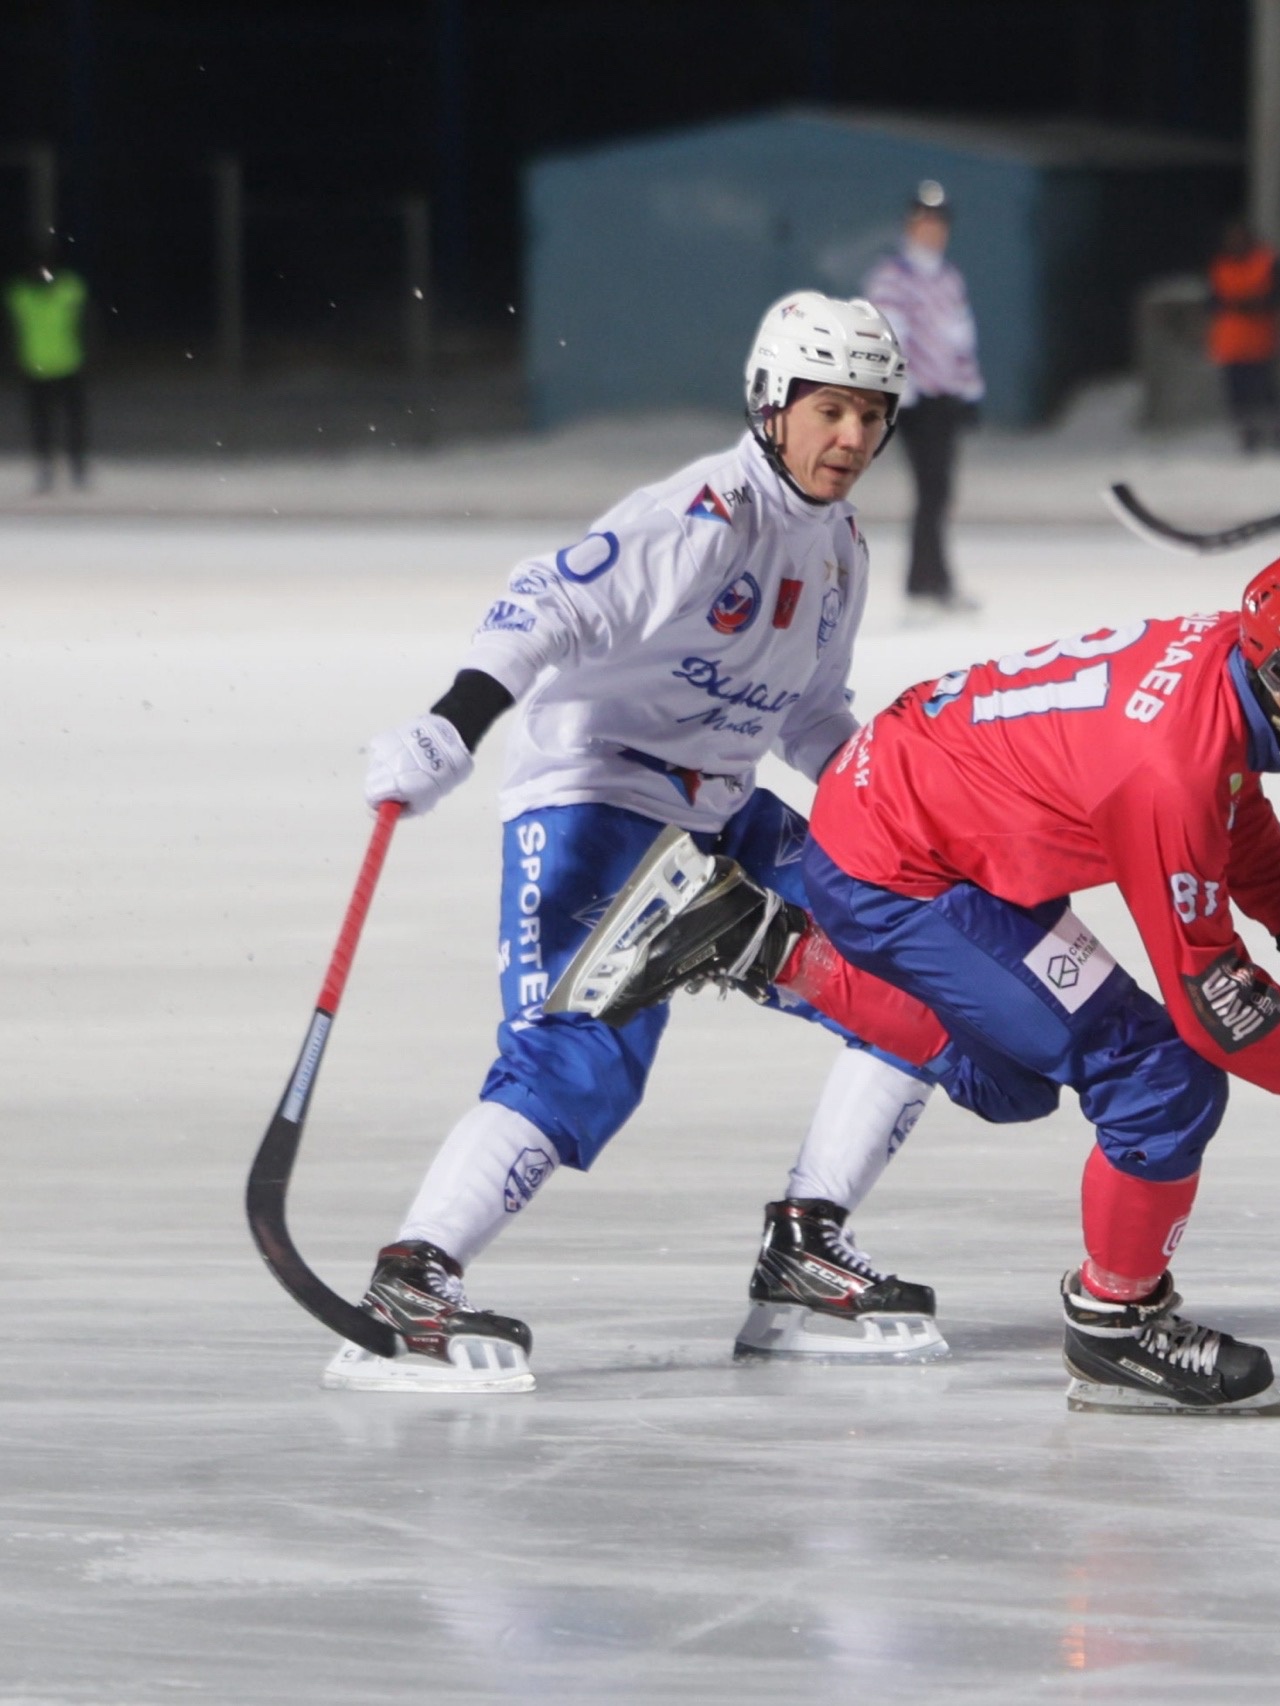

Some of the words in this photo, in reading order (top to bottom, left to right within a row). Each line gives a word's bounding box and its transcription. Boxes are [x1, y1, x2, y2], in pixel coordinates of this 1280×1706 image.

[850, 350, 890, 363] CCM
[722, 486, 752, 507] РМ
[972, 619, 1148, 725] 81
[1170, 871, 1220, 924] 81
[804, 1260, 851, 1289] CCM
[404, 1292, 446, 1311] CCM
